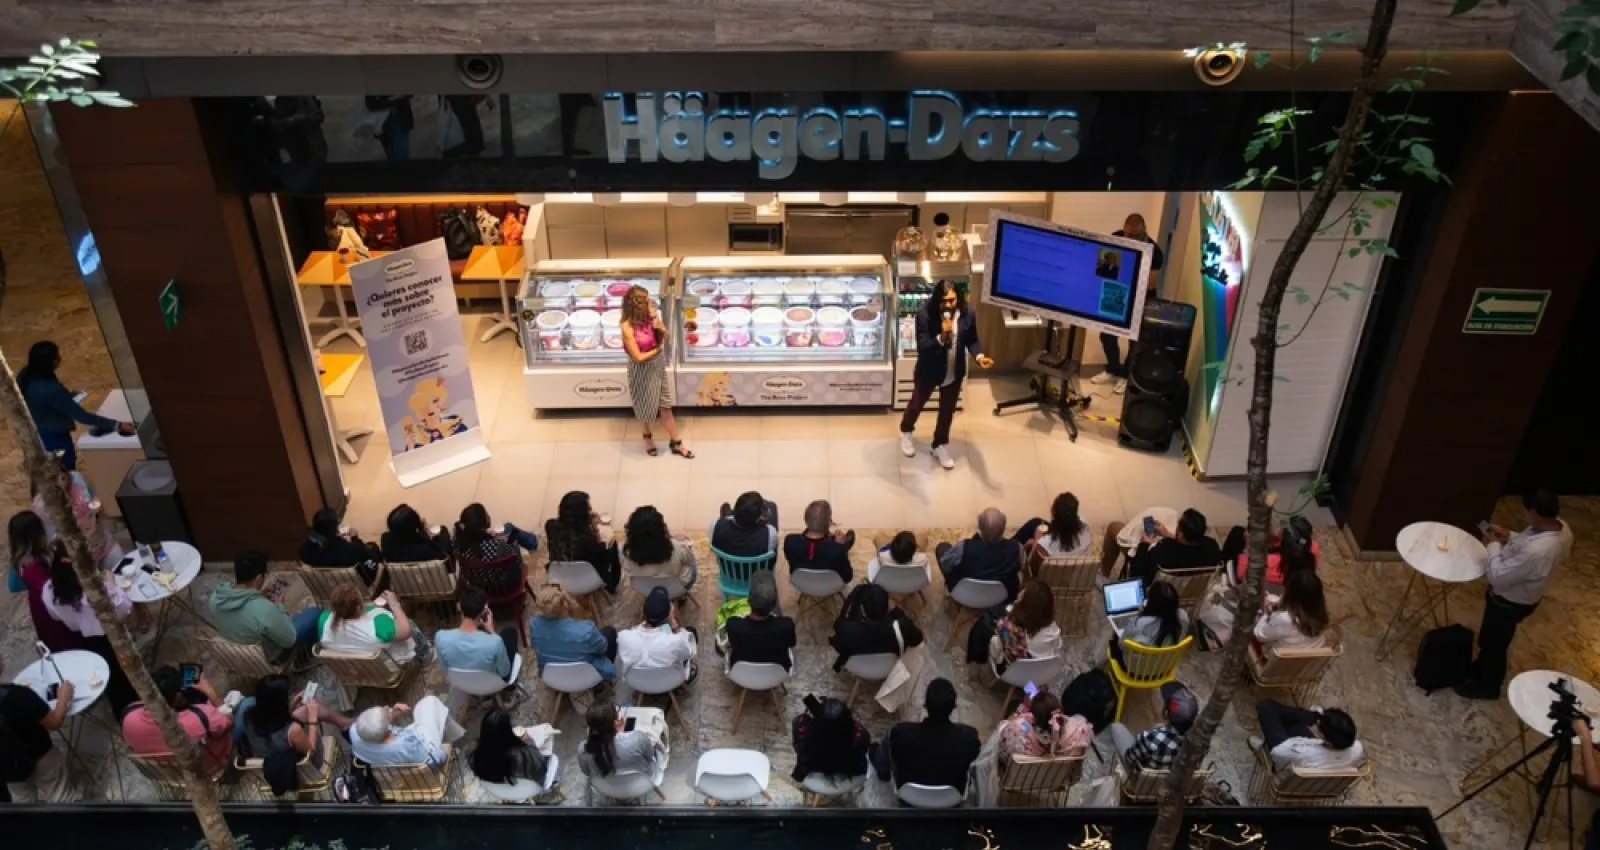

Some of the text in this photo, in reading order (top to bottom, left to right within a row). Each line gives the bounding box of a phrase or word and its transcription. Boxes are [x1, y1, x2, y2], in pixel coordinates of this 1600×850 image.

[602, 89, 1080, 180] Häagen-Dazs
[407, 275, 443, 291] conocer
[404, 288, 430, 302] sobre
[381, 294, 435, 318] el proyecto?
